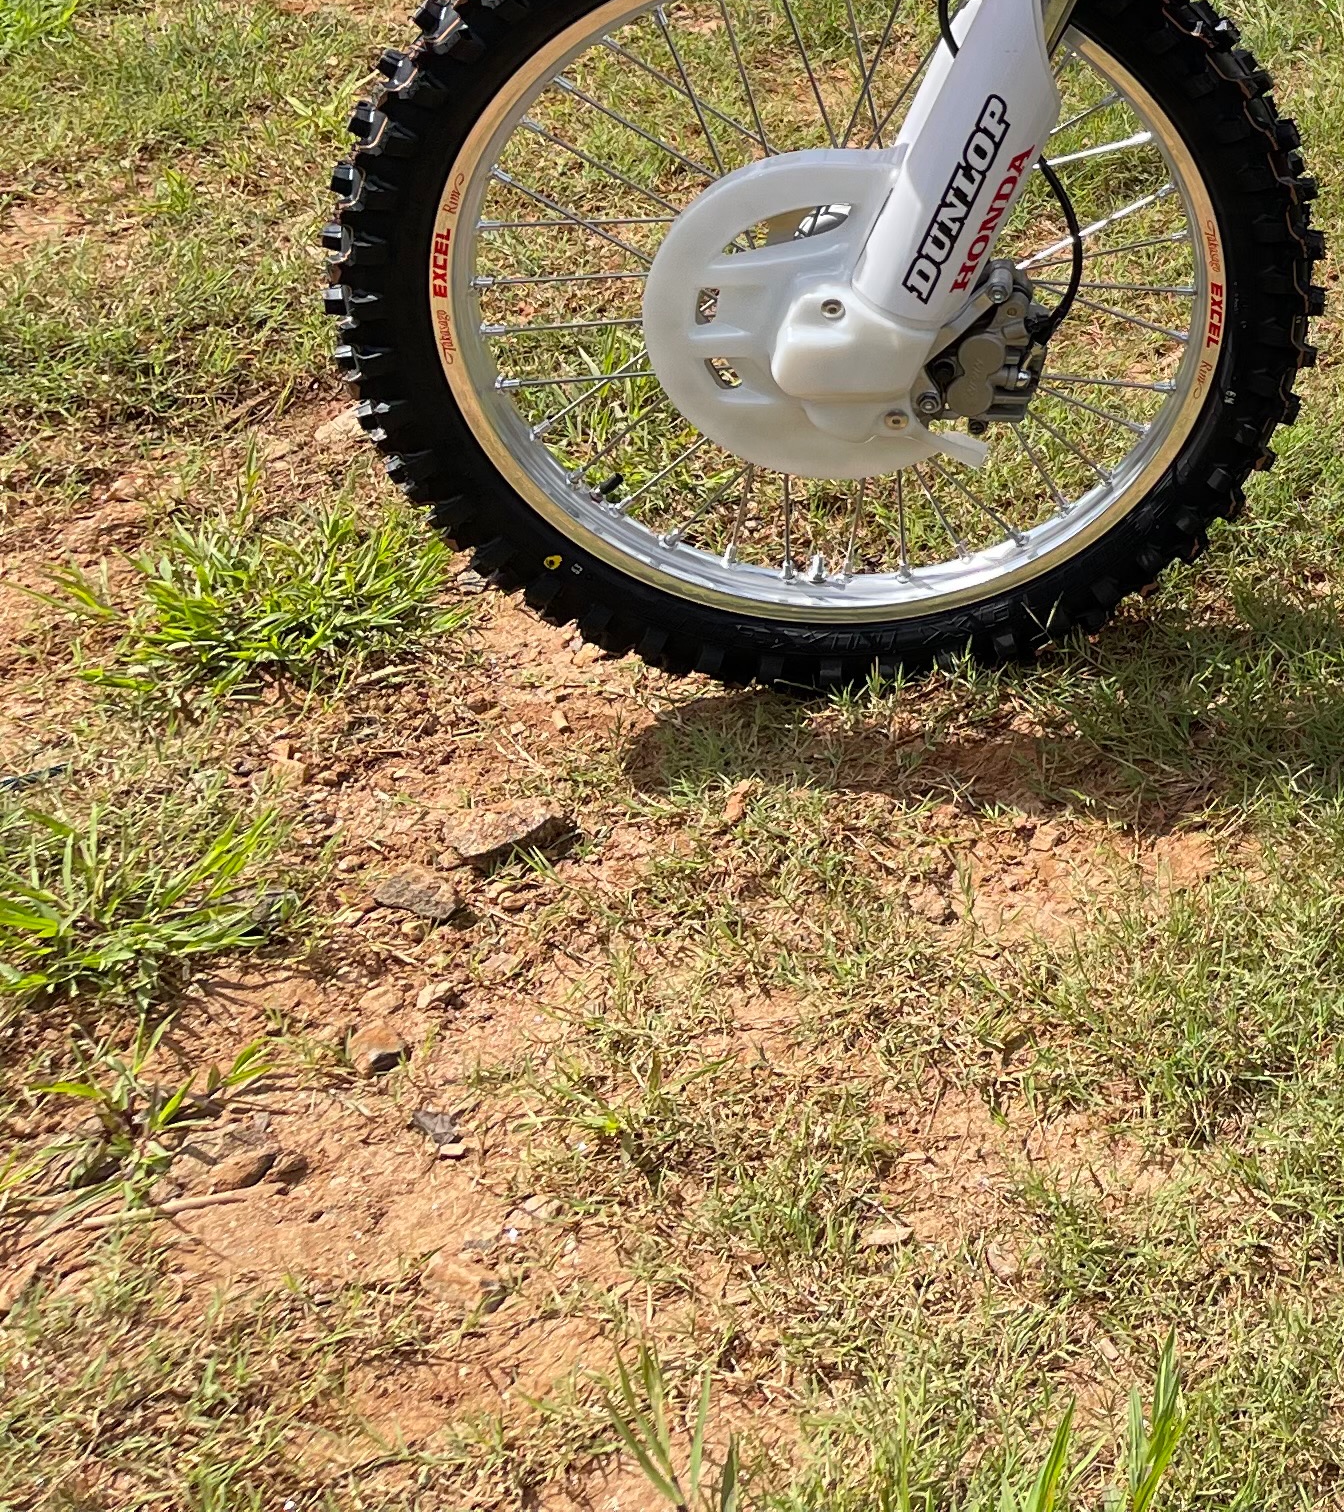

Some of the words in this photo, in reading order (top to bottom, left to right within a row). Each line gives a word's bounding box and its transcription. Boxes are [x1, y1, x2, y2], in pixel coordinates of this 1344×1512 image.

[902, 94, 1010, 304] DUNLOP
[949, 144, 1035, 293] HONDA
[433, 228, 451, 299] EXCEL
[1207, 281, 1223, 348] EXCEL
